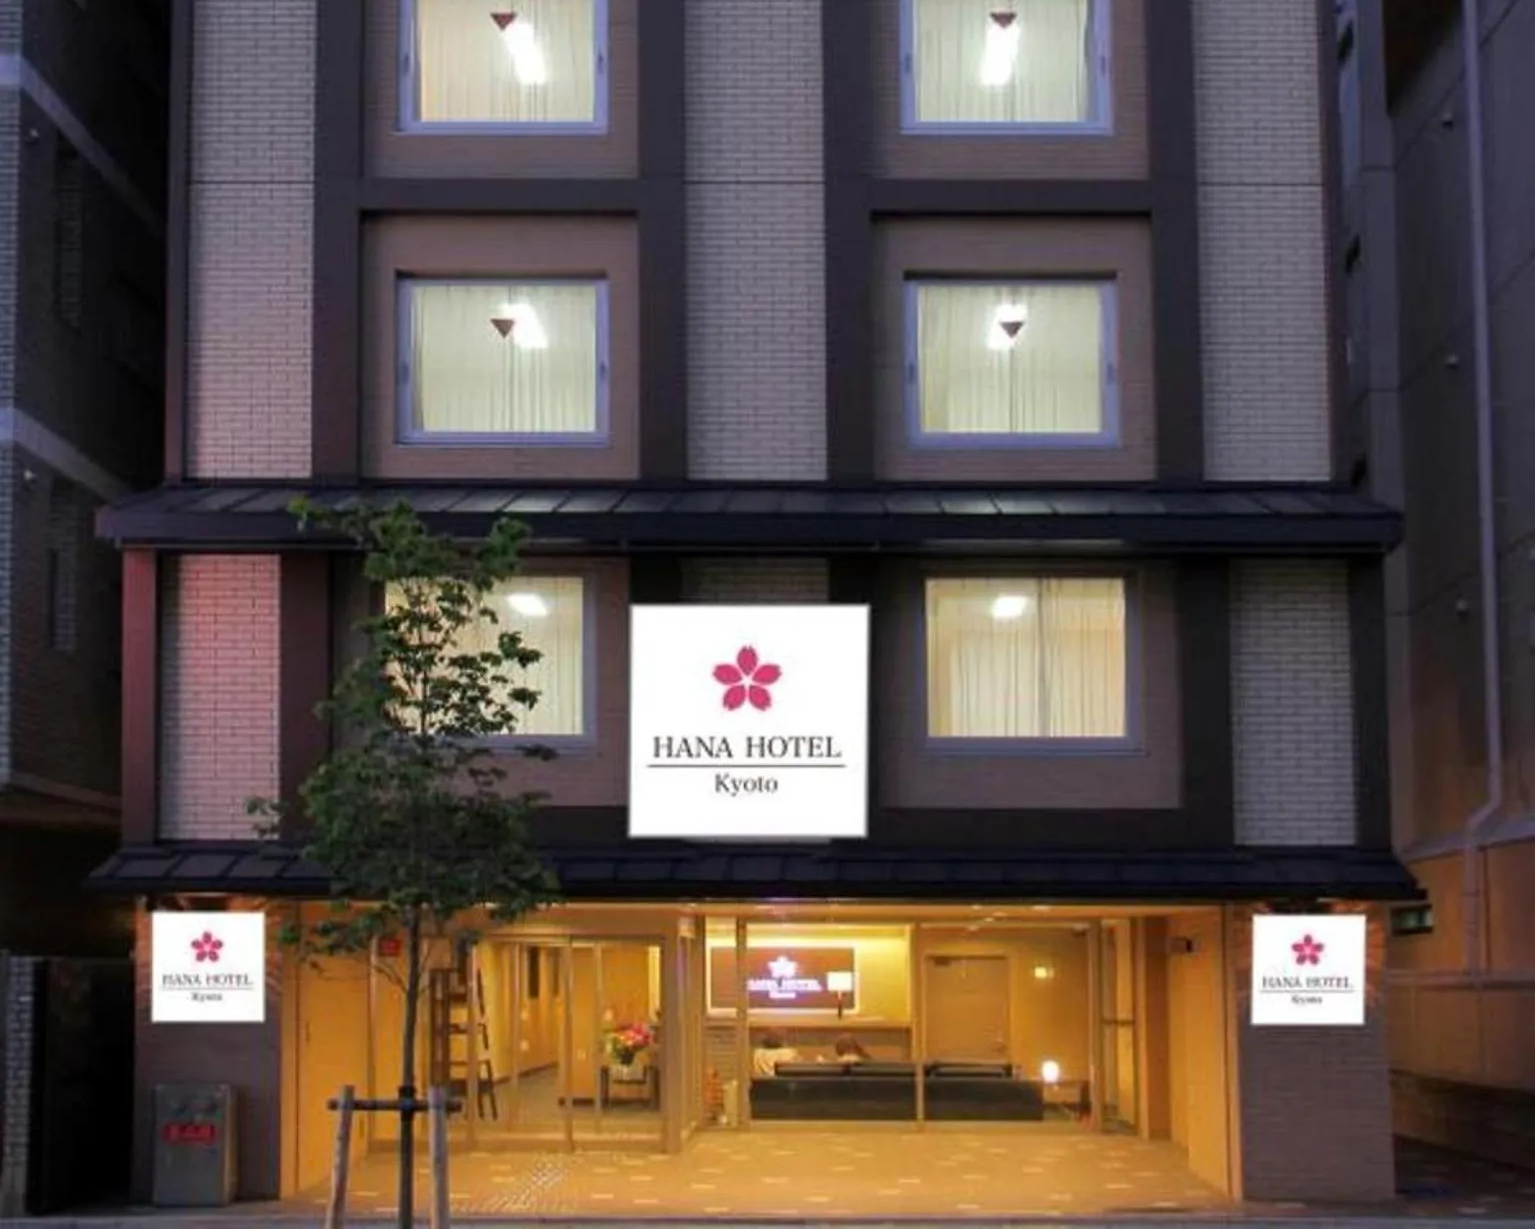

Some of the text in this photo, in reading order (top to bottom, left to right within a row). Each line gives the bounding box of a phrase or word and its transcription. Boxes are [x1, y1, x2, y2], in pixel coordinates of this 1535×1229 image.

[653, 735, 842, 759] HANA HOTEL
[714, 773, 779, 798] Kyoto
[161, 973, 253, 986] HANA HOTEL
[1261, 976, 1354, 988] HANA HOTEL
